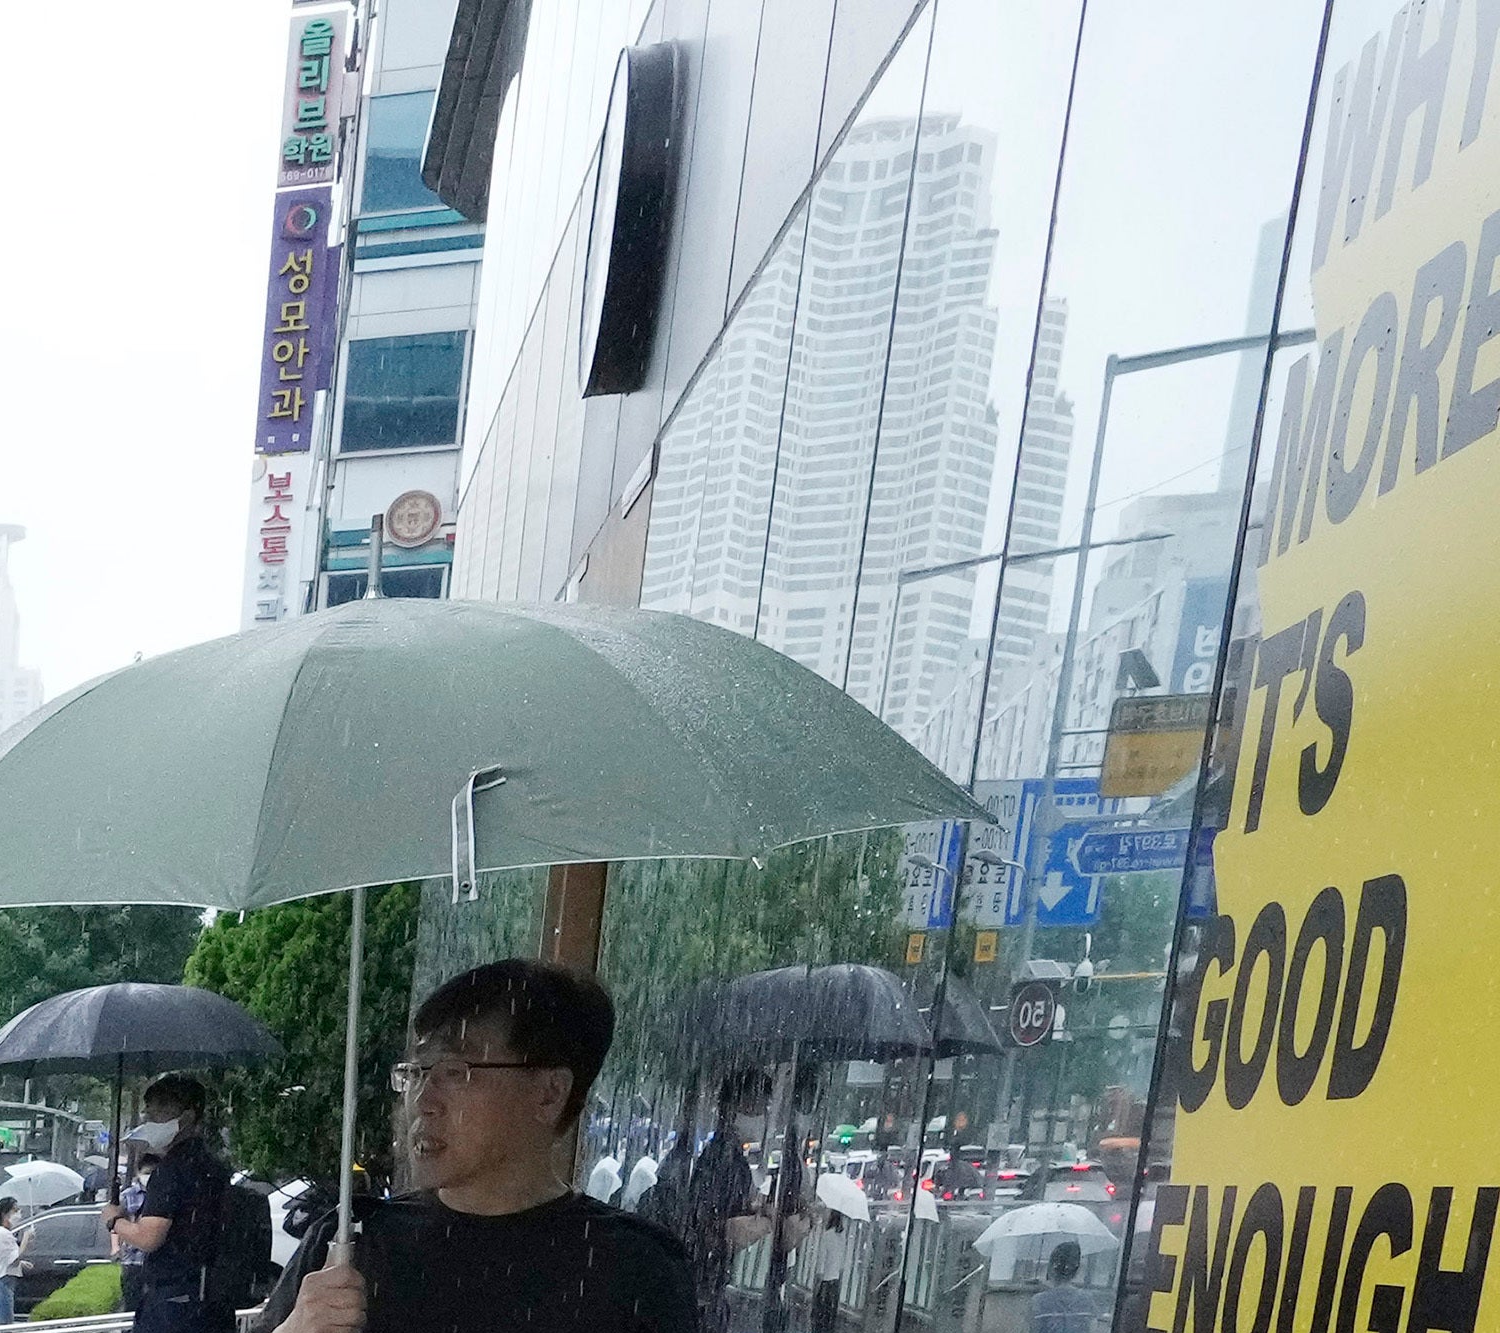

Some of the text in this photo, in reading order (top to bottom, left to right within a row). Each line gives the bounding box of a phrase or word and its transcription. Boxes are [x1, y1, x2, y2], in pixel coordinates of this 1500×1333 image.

[293, 18, 335, 132] 올리브
[266, 248, 313, 422] 성모안과
[1208, 591, 1365, 837] IT'S
[1168, 874, 1407, 1113] GOOD
